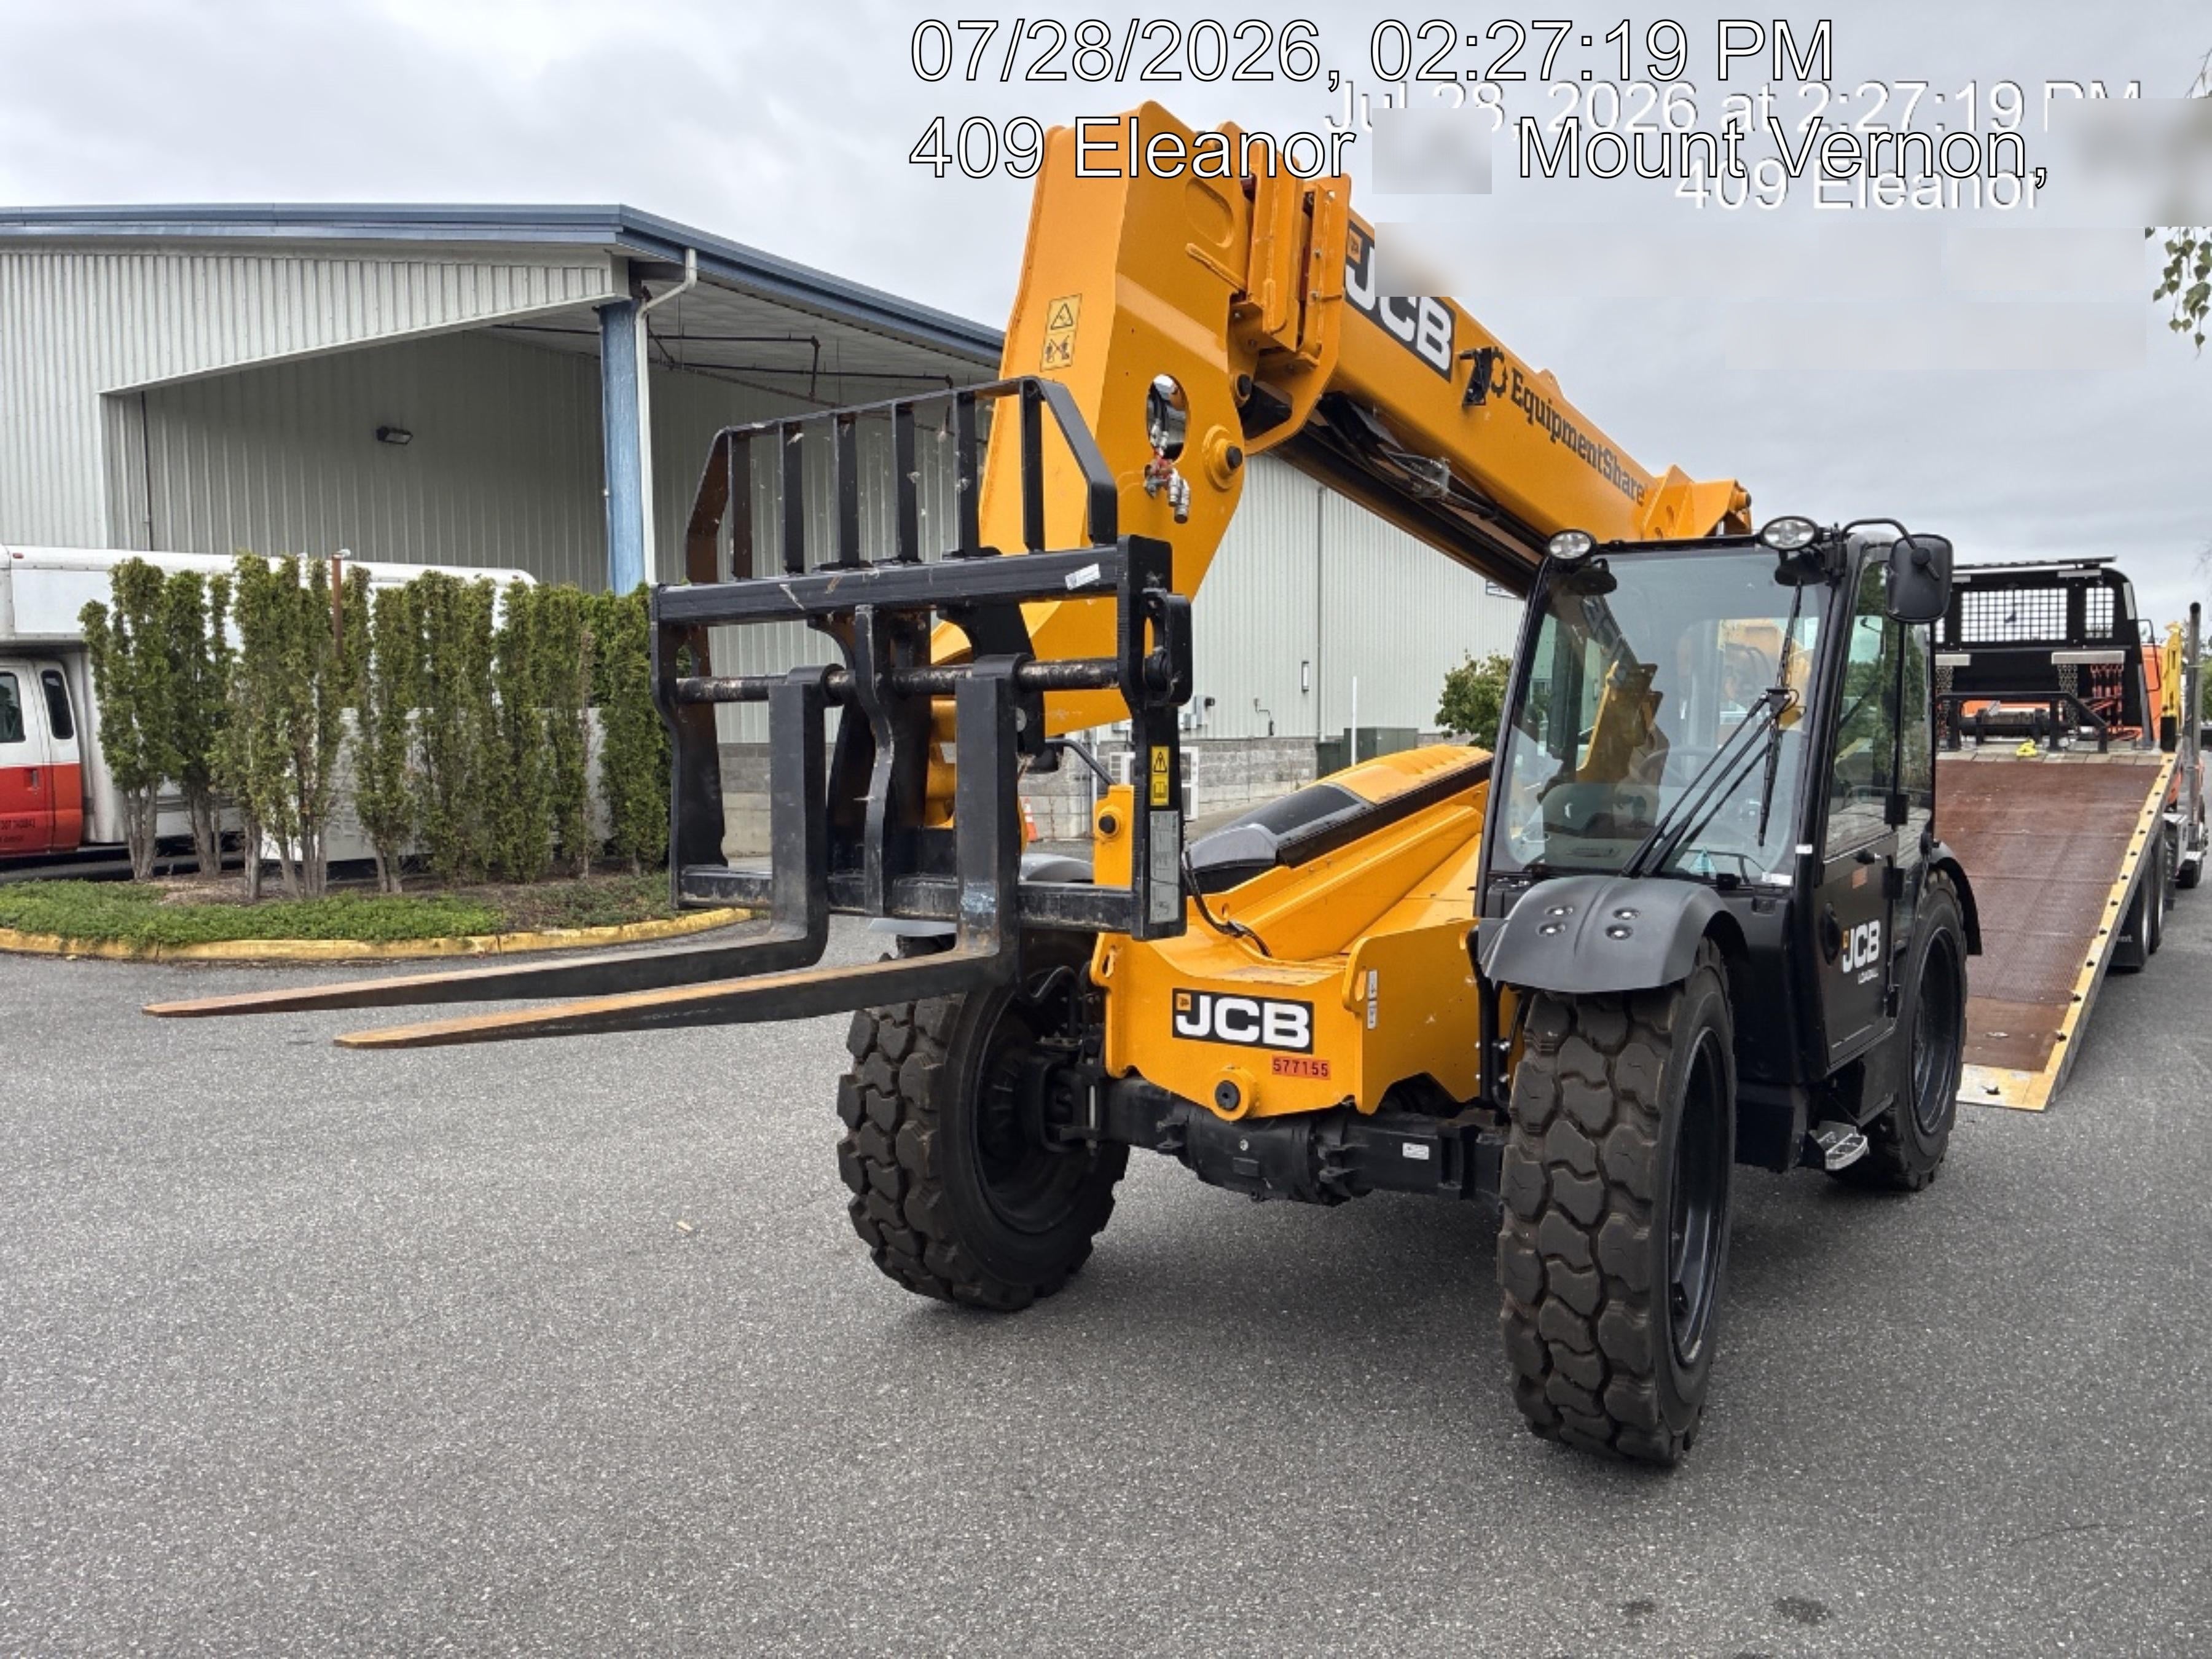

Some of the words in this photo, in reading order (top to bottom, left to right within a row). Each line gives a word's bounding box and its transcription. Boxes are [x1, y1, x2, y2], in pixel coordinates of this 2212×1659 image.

[1511, 367, 1645, 508] EquipmentShare
[1842, 919, 1881, 974] JCB
[1175, 994, 1310, 1048] JCB
[1273, 1057, 1328, 1077] 577155
